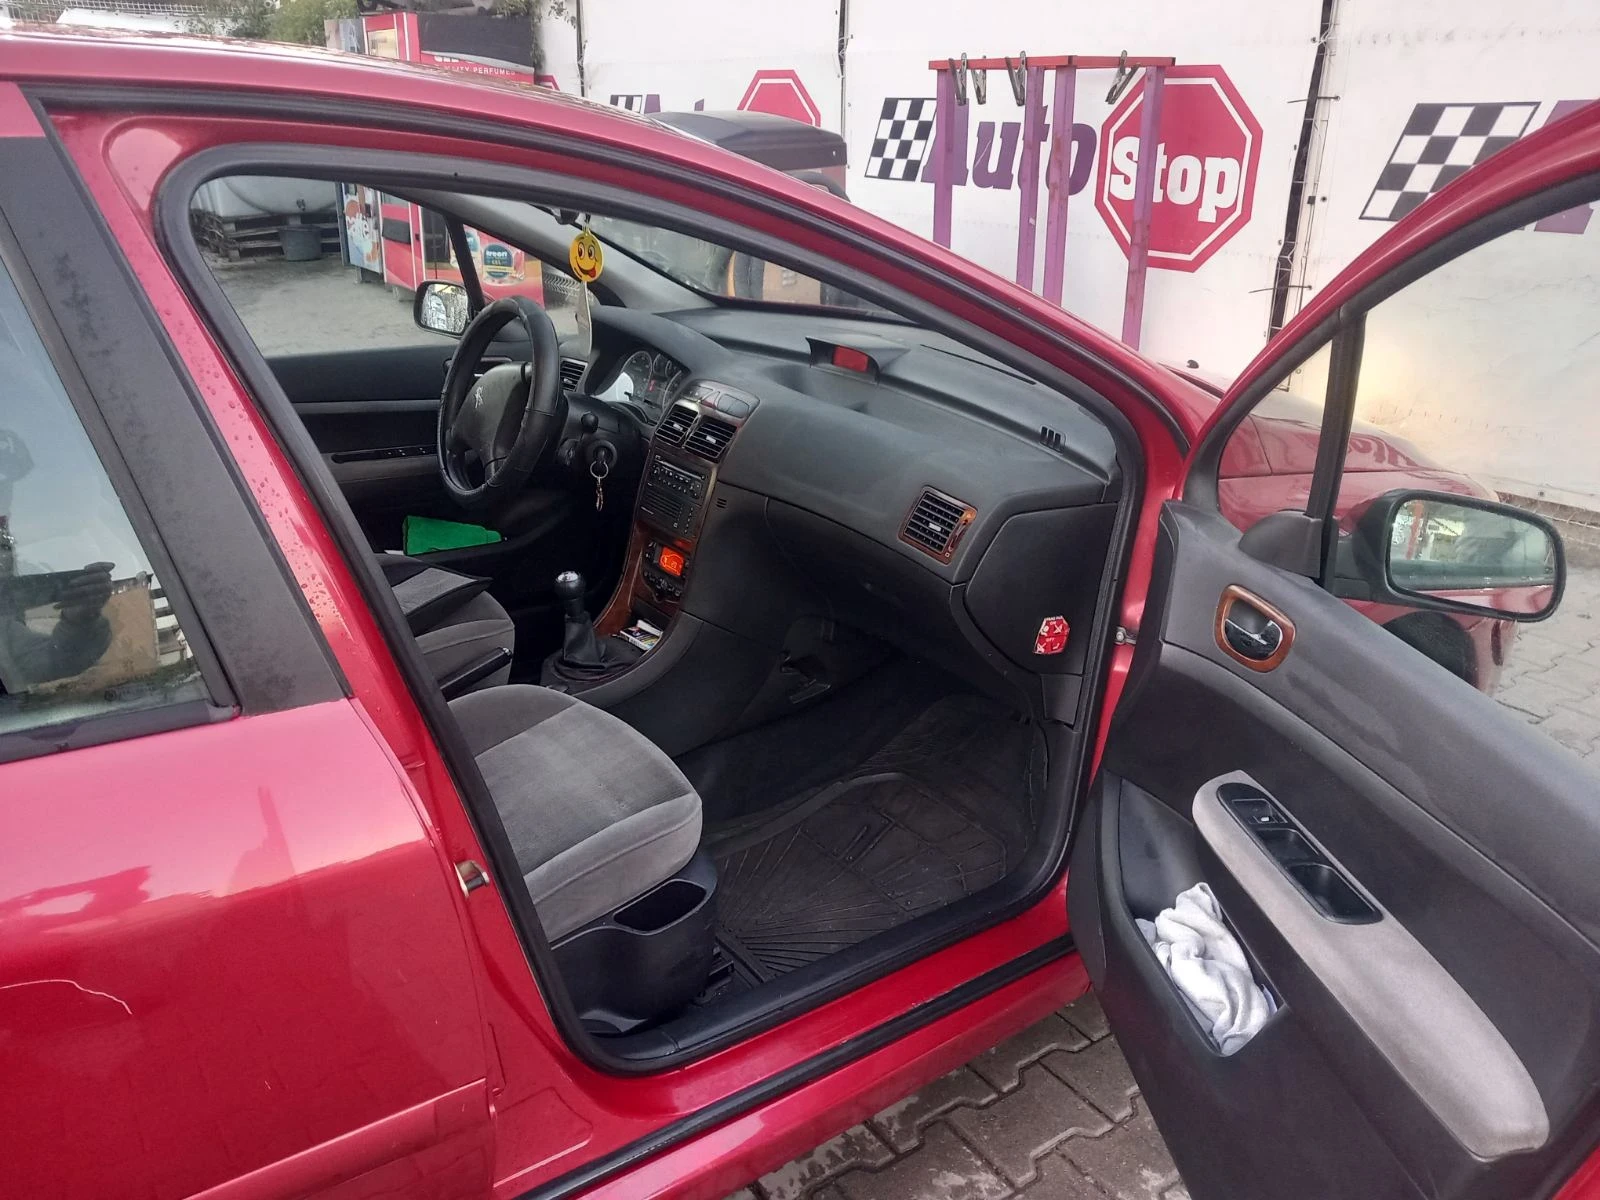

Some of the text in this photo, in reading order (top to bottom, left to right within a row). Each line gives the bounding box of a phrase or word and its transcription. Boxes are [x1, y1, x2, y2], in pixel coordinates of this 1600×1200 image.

[473, 66, 516, 76] PERFUMES
[921, 98, 1240, 223] Auo Stop
